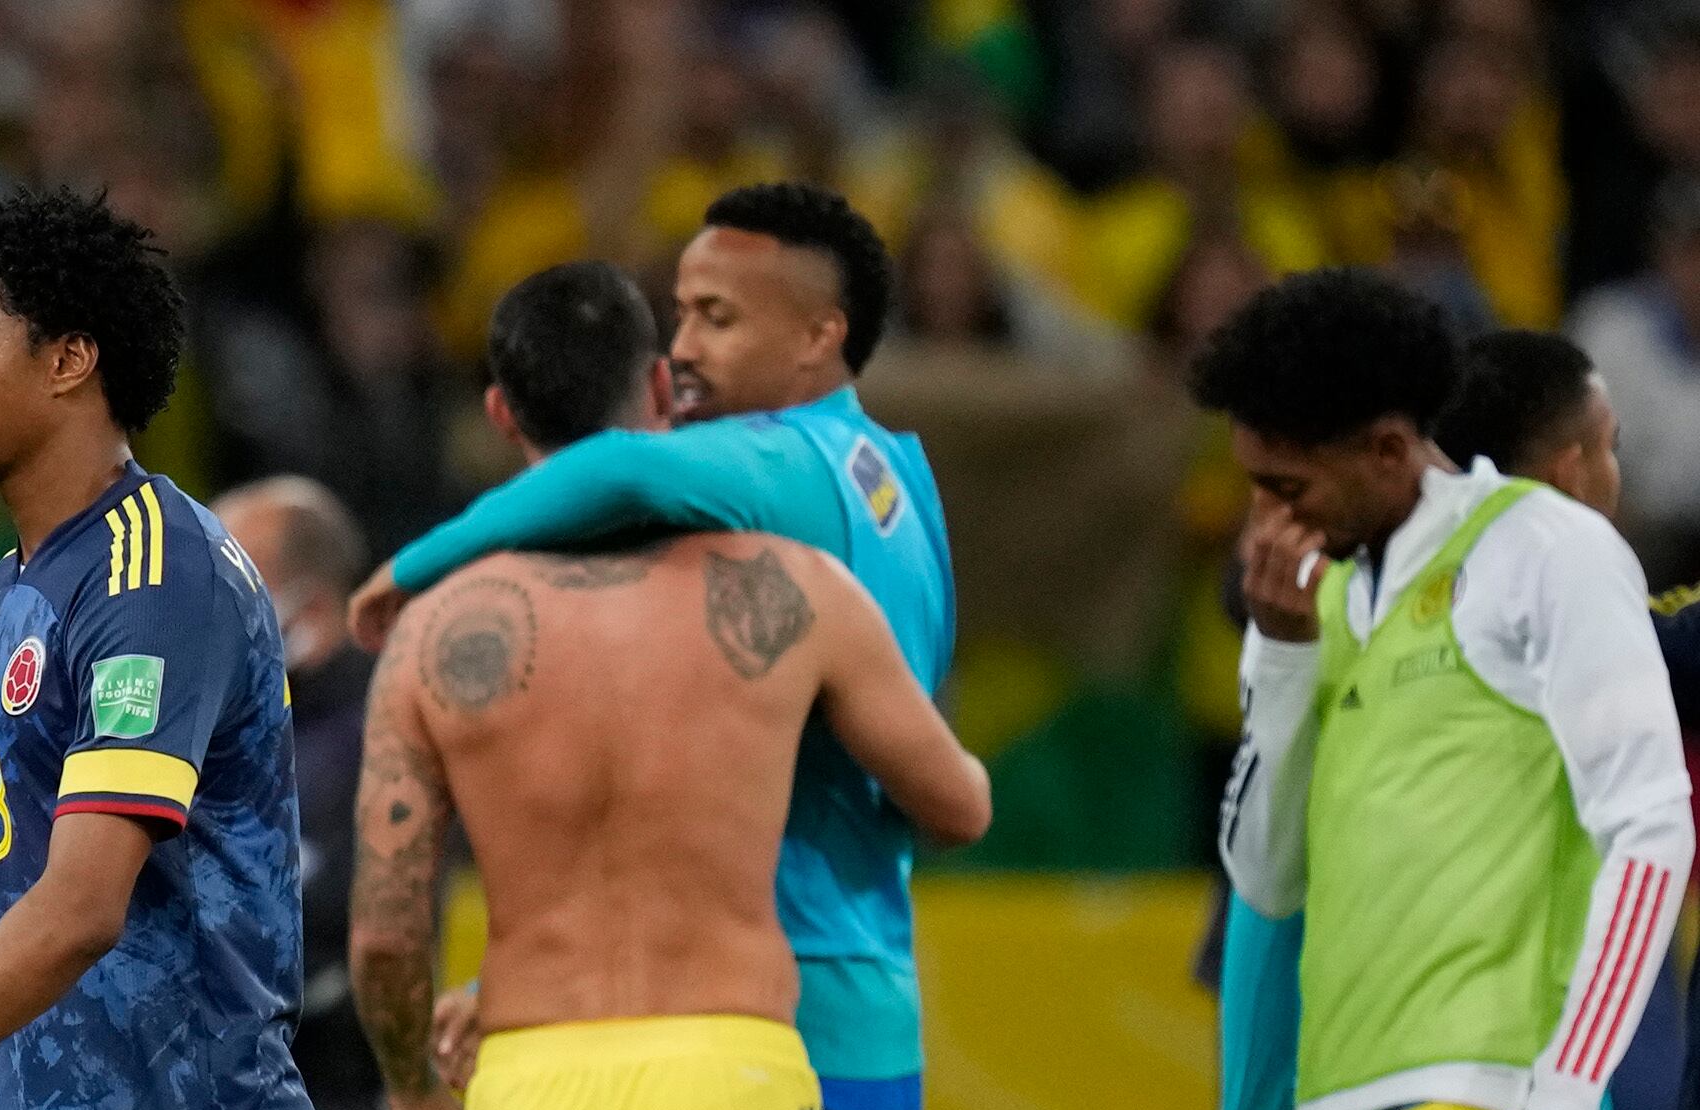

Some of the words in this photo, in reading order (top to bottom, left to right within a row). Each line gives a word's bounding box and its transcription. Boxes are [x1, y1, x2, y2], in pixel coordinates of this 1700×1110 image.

[98, 678, 155, 691] LIVING
[98, 686, 152, 701] FOOTBALL
[125, 703, 151, 718] FIFA
